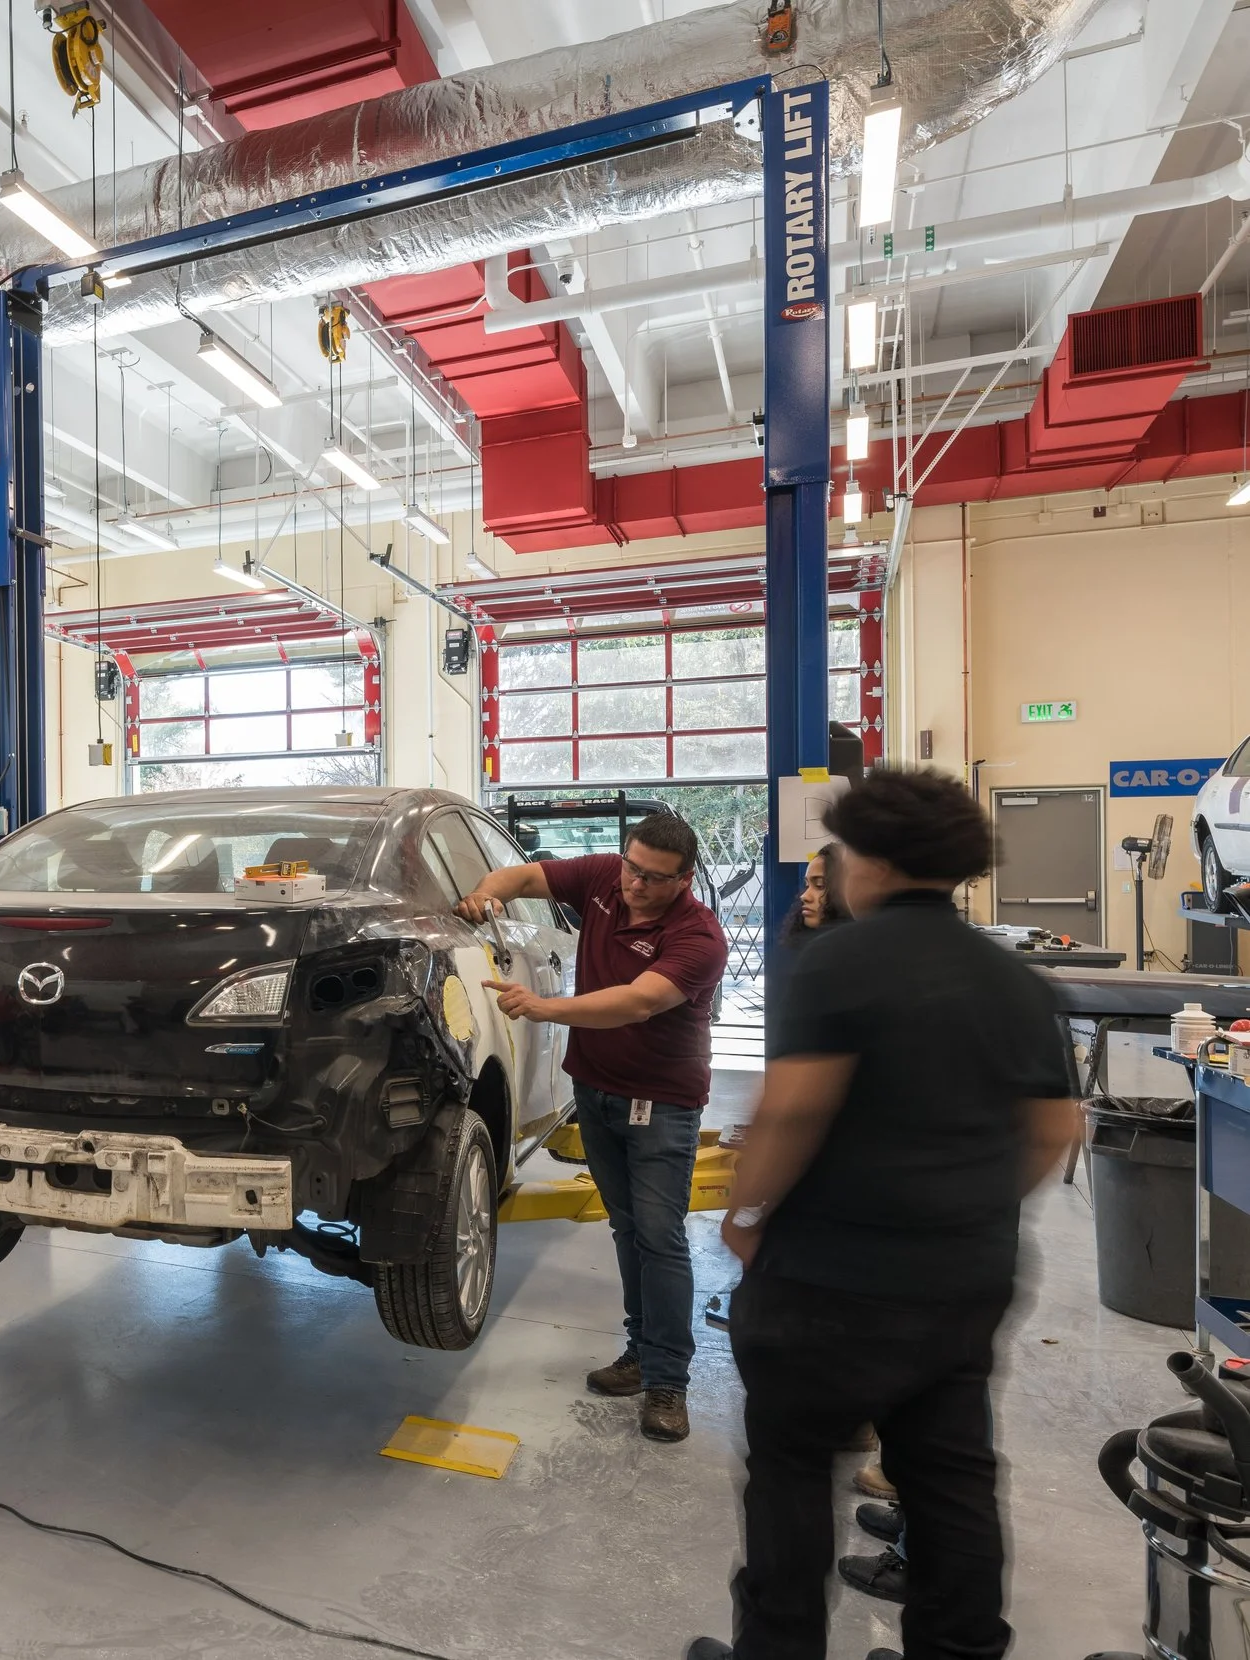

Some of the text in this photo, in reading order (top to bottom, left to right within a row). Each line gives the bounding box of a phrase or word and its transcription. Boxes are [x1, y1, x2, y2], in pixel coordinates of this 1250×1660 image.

[783, 92, 815, 302] ROTARY LIFT
[1028, 704, 1053, 720] EXIT
[1084, 794, 1094, 802] 12
